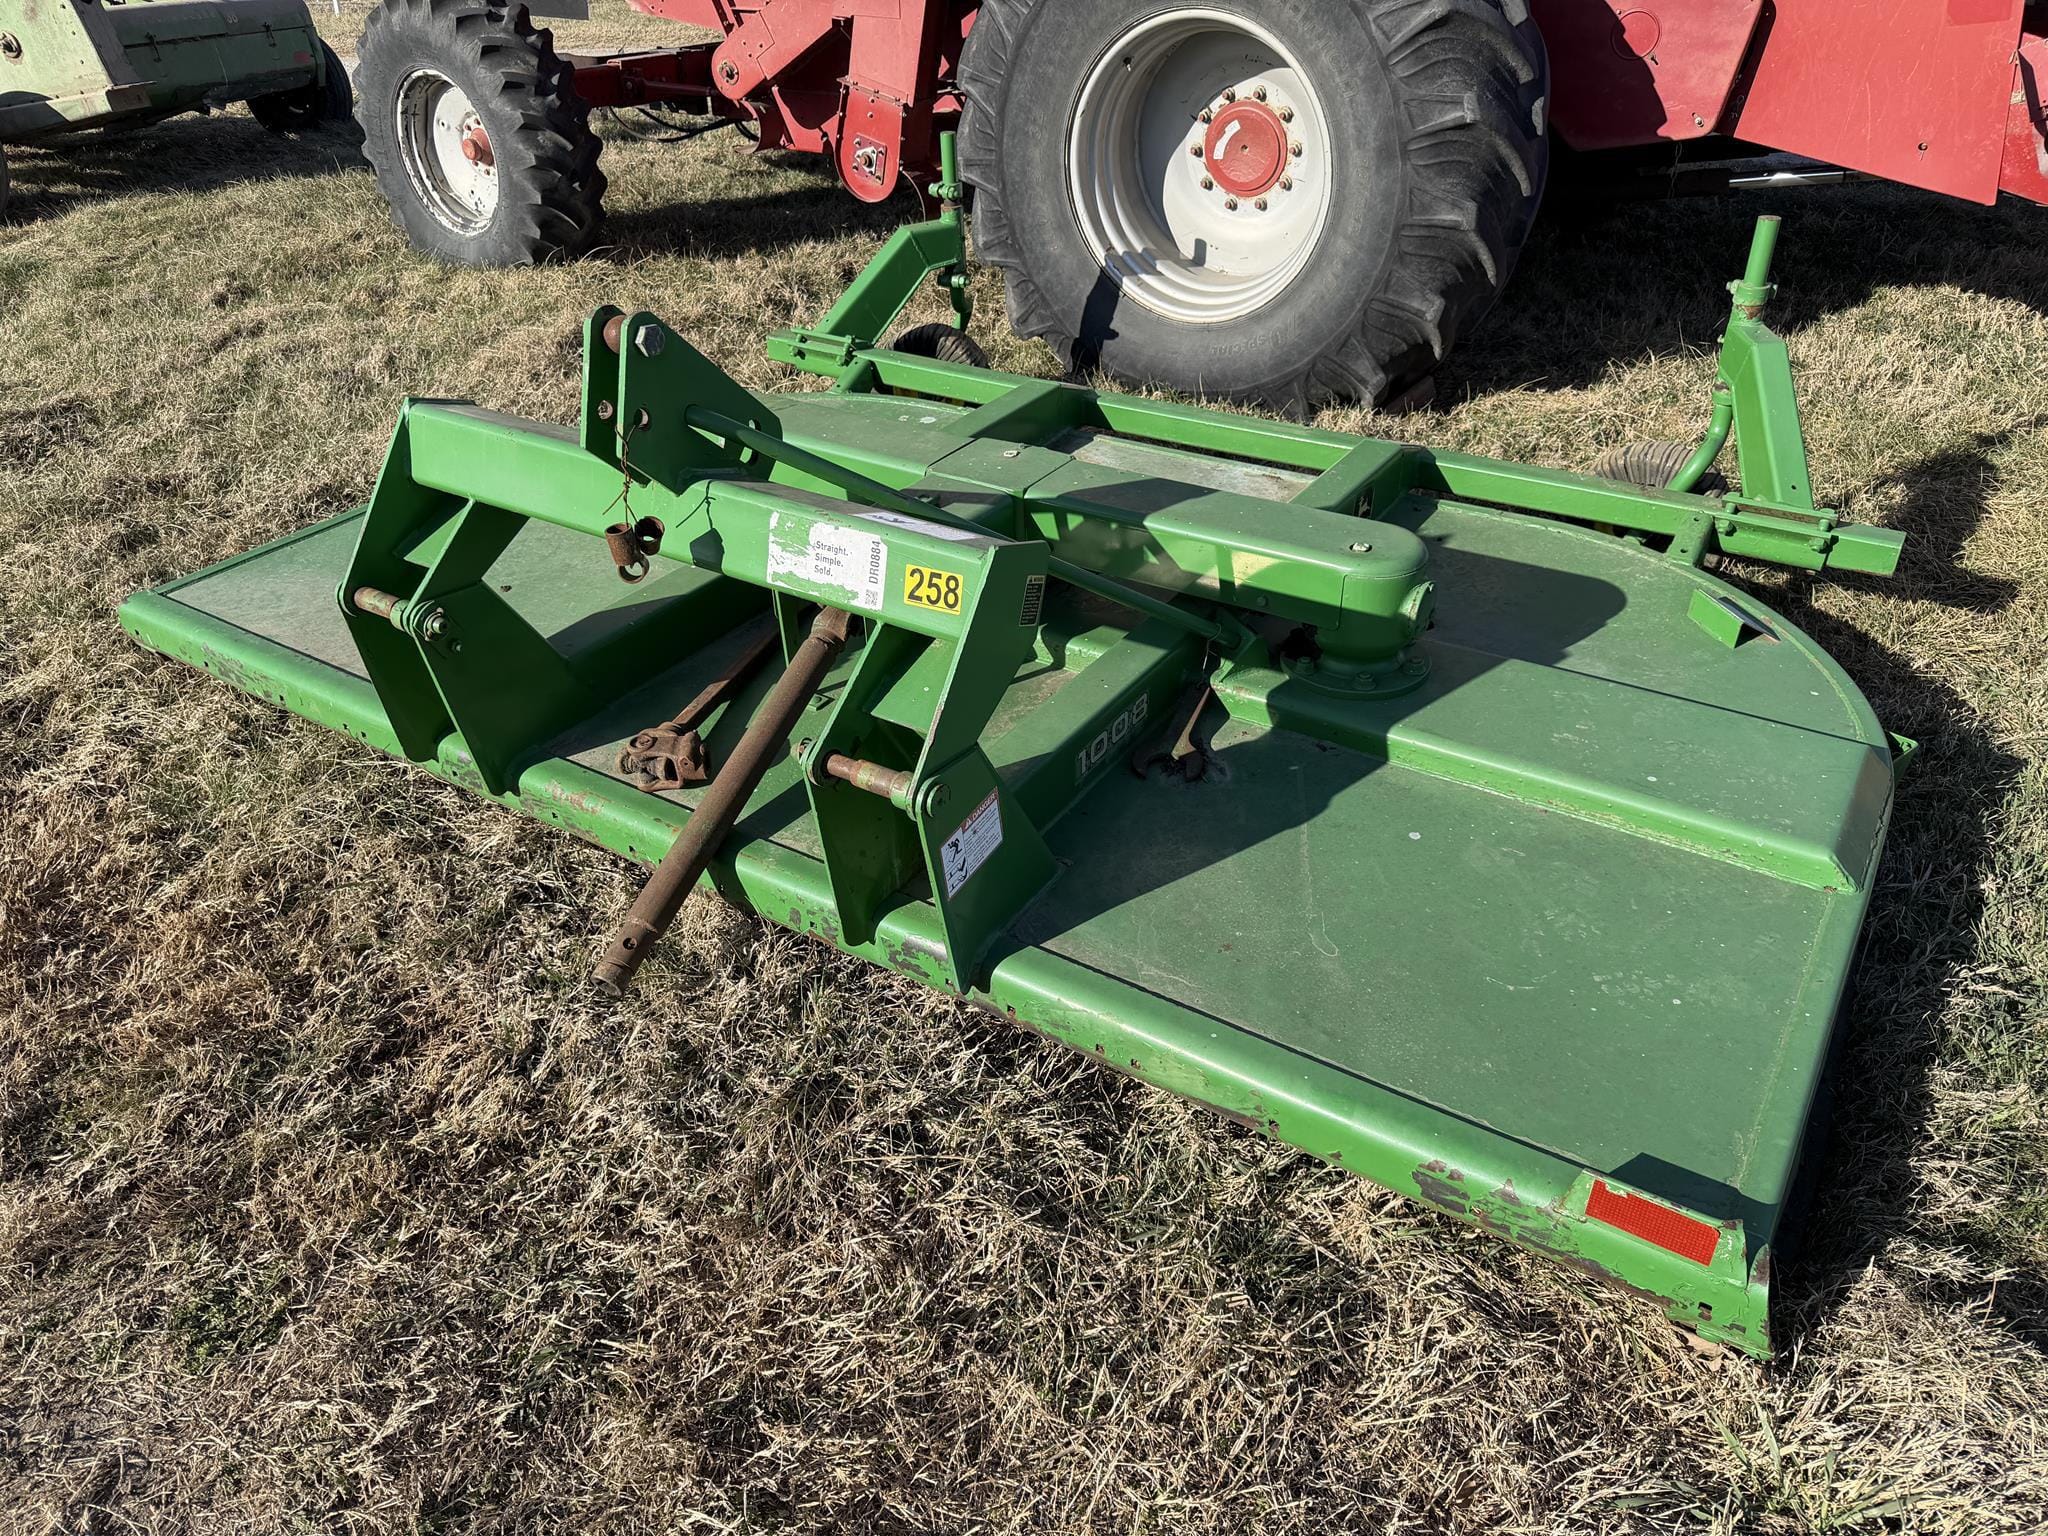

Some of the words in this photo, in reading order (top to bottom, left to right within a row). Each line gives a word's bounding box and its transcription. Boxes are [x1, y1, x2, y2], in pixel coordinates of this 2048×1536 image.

[815, 552, 844, 567] Simple.
[816, 540, 849, 556] Straight.
[868, 540, 881, 584] DR0884
[814, 564, 833, 577] Sold.
[908, 568, 960, 609] 258
[1078, 693, 1148, 775] 1008
